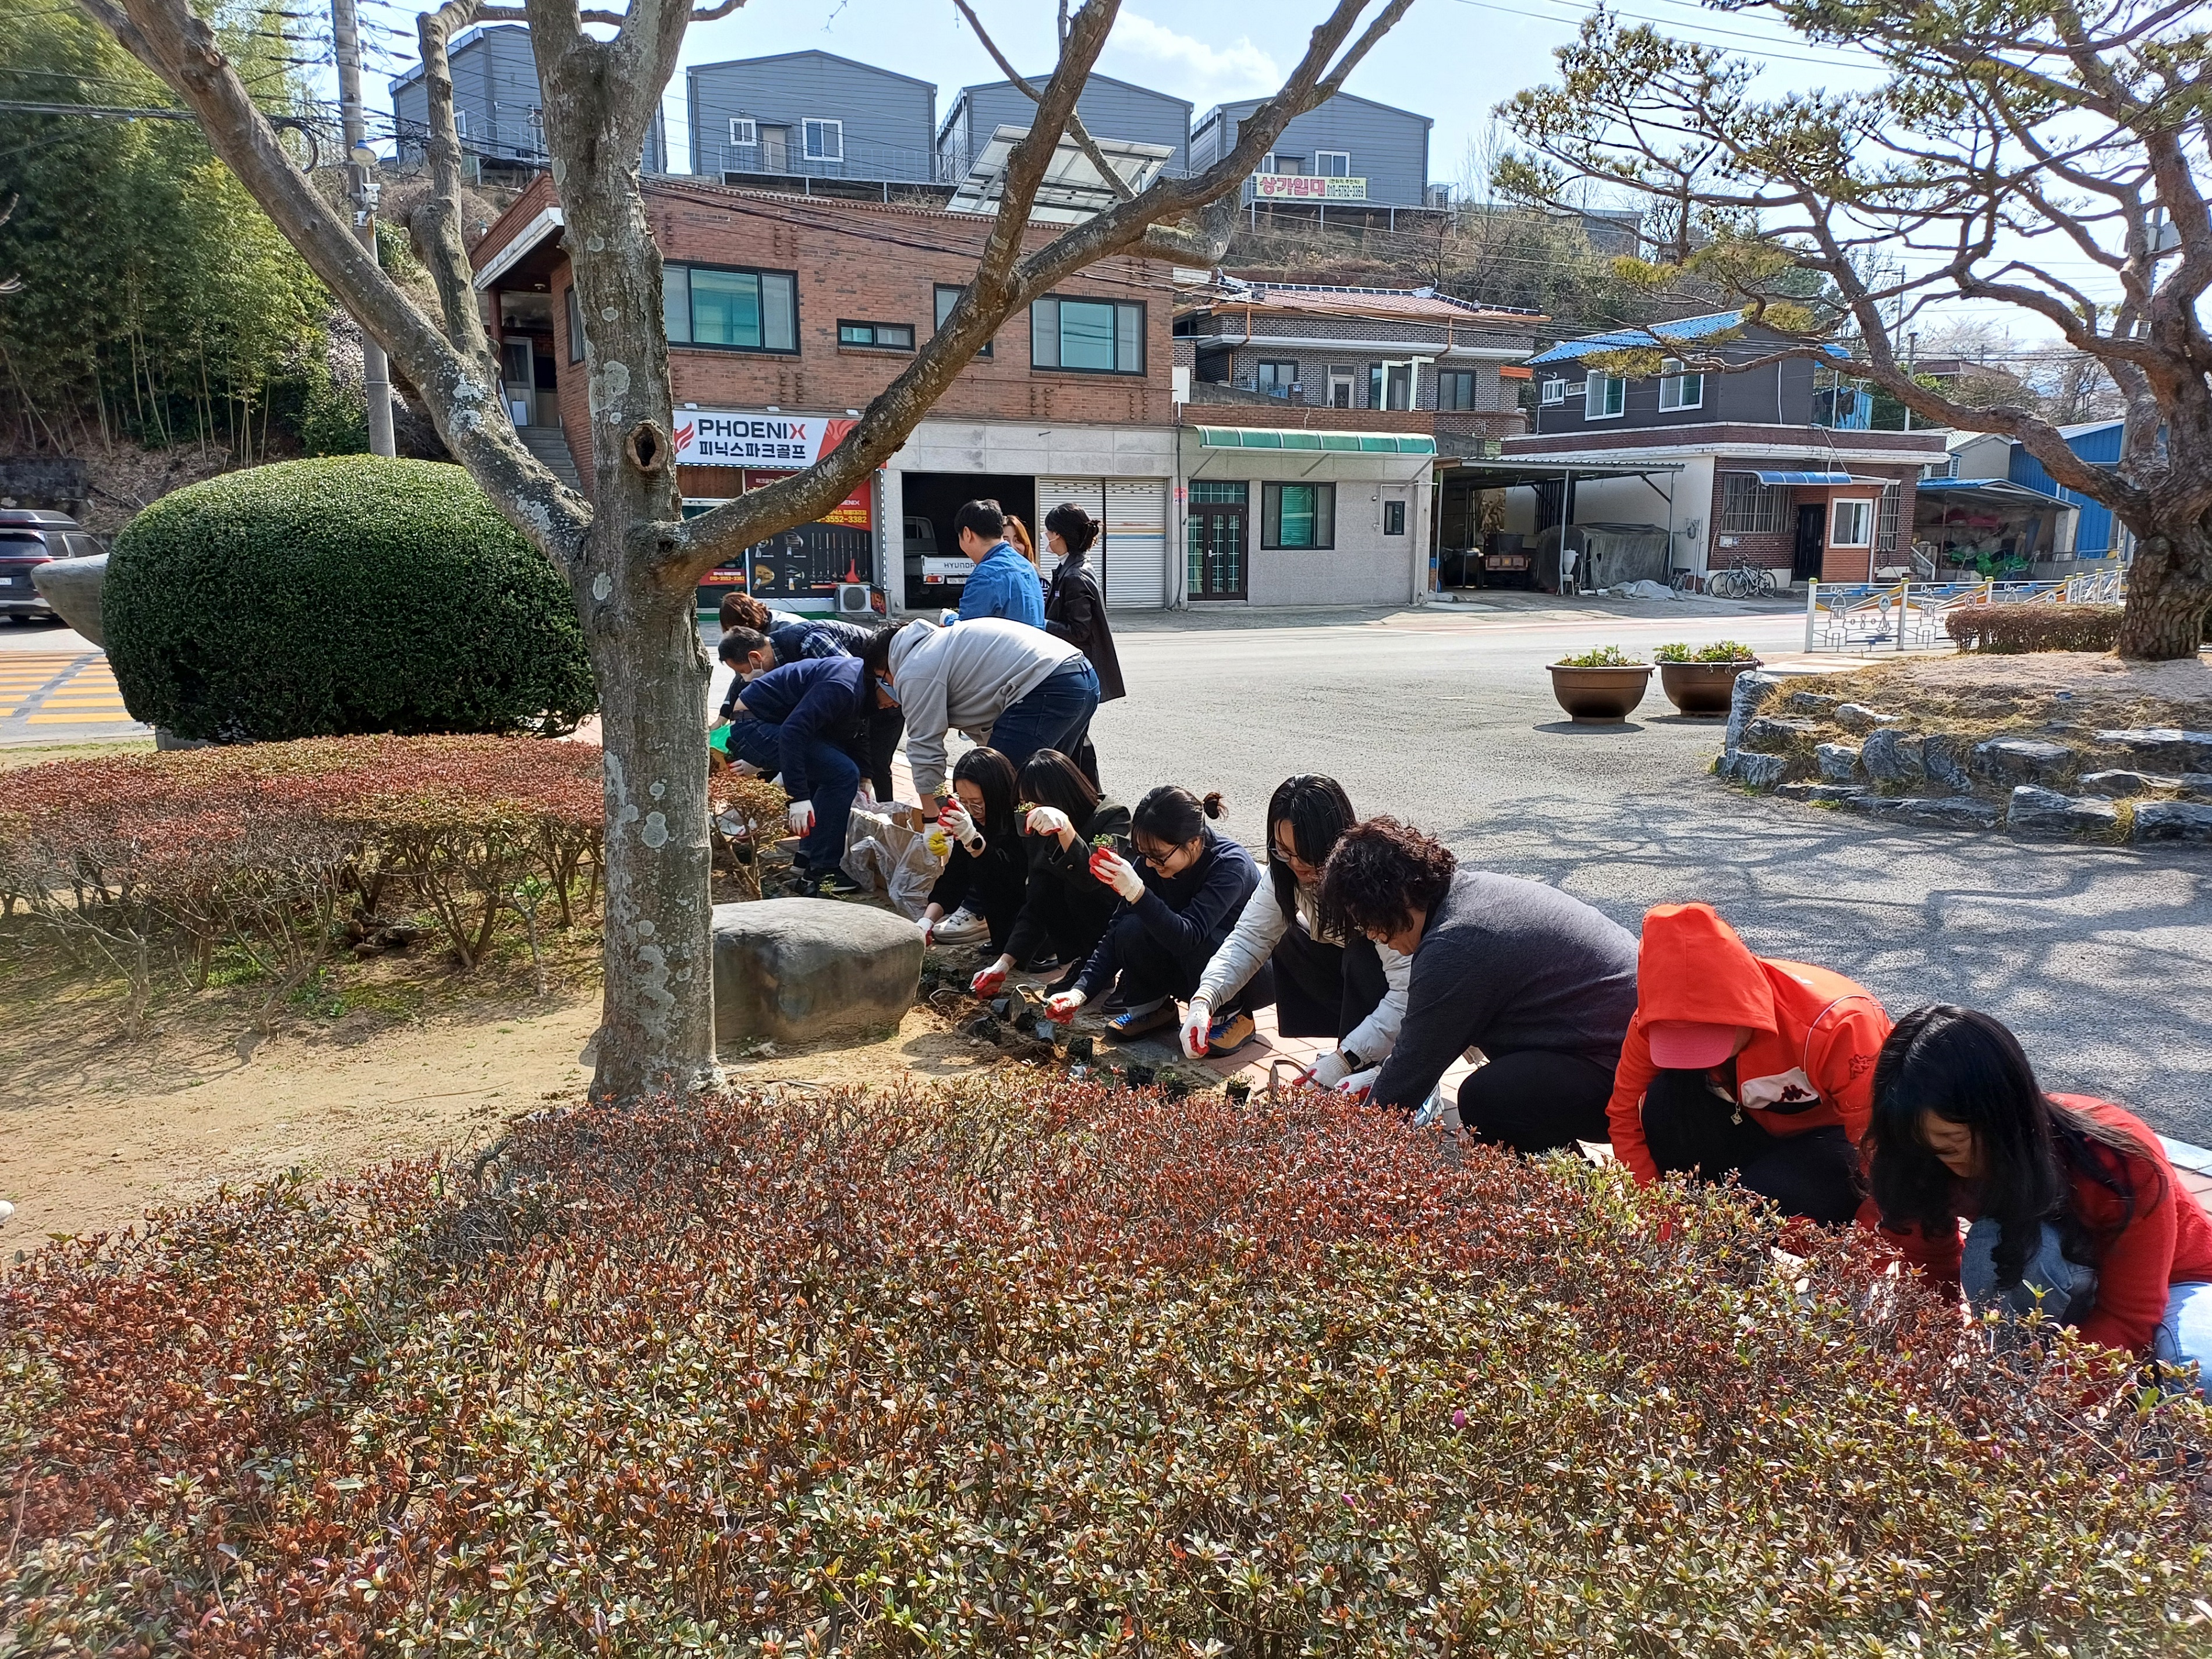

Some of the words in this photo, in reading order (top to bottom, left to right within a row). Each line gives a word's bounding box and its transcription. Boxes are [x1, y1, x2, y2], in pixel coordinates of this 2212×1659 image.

[1259, 176, 1325, 197] 상가임대
[698, 419, 806, 440] PHOENIX
[699, 441, 806, 459] 피닉스파크골프
[813, 515, 867, 523] -3552-3382
